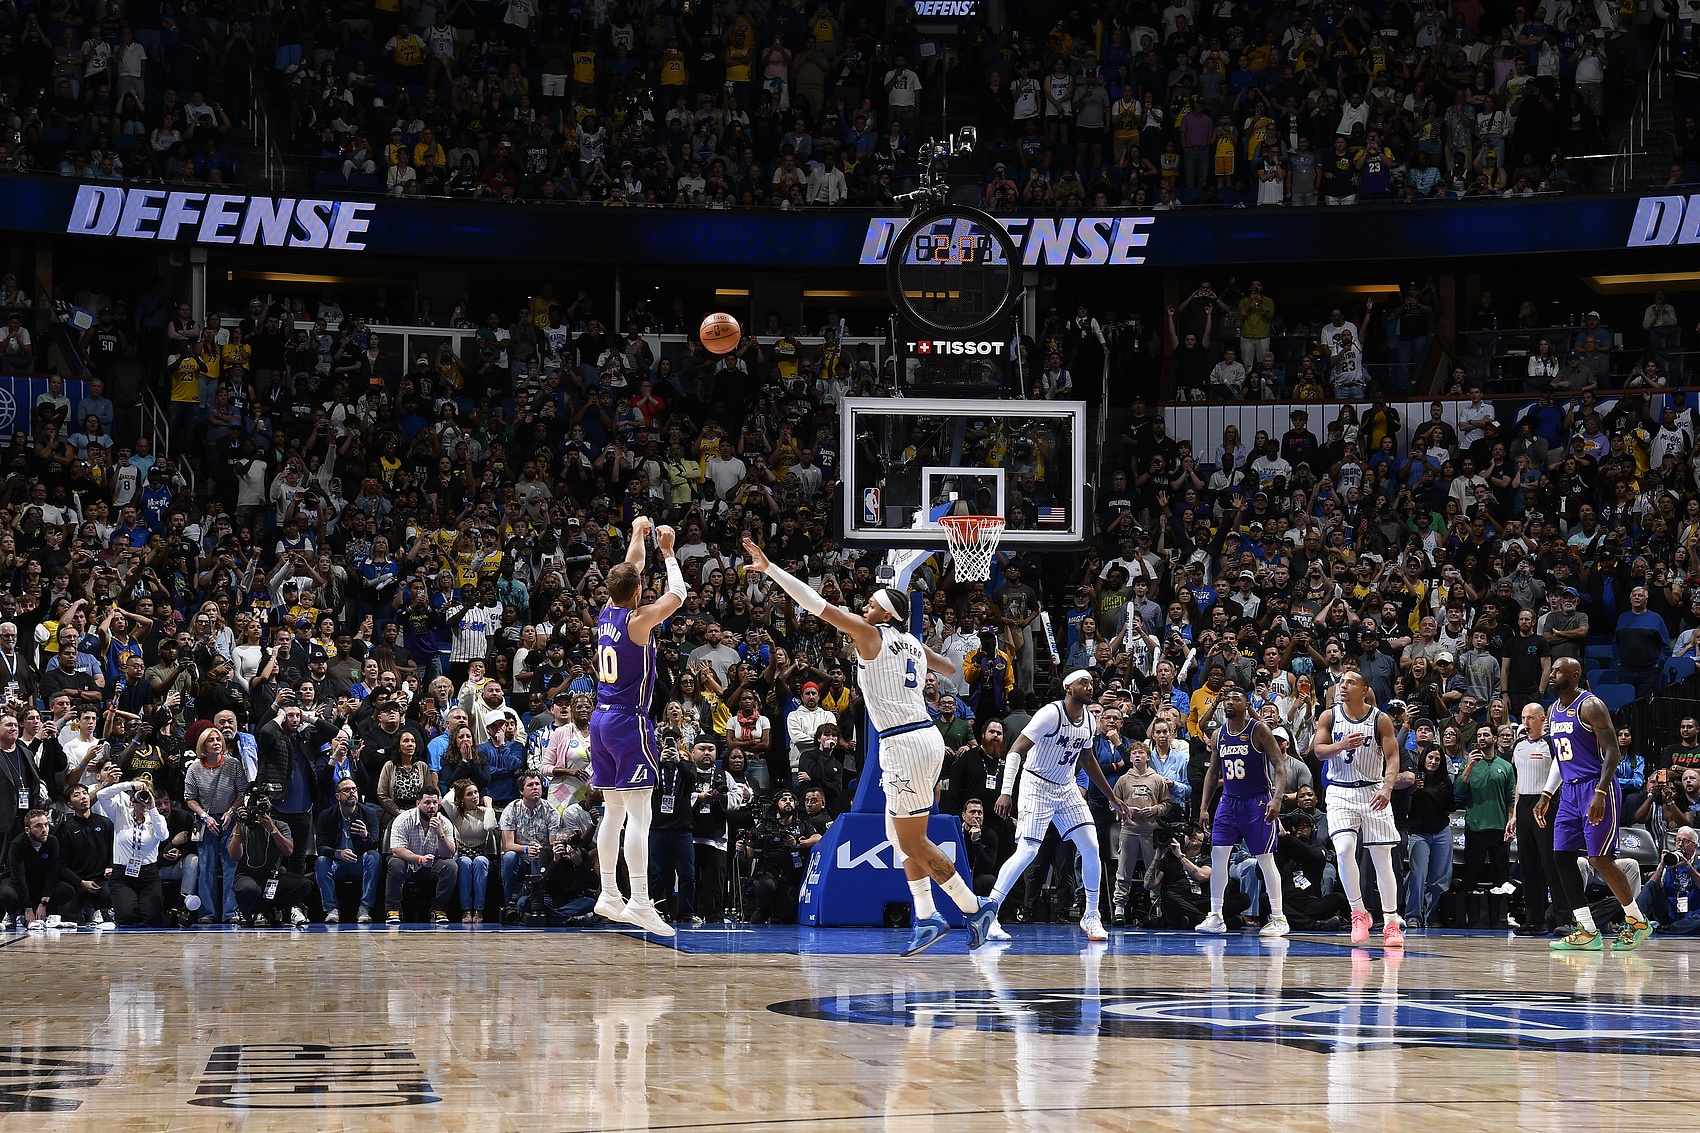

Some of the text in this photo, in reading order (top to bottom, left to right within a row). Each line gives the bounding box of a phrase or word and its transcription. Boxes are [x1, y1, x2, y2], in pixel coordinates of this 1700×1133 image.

[914, 0, 979, 16] DEFENS
[820, 22, 827, 30] 15
[404, 52, 415, 61] 77
[1372, 56, 1384, 64] 23
[669, 63, 680, 71] 23
[1220, 136, 1228, 144] 77
[1369, 162, 1381, 173] 23
[66, 185, 377, 250] DEFENSE
[102, 341, 114, 351] 50
[933, 342, 1004, 355] TISSOT
[1342, 361, 1357, 372] 23
[181, 372, 194, 383] 23
[1627, 445, 1634, 455] 6
[1665, 442, 1676, 451] 15
[990, 451, 997, 461] 6
[781, 457, 794, 467] 23
[123, 481, 131, 491] 8
[1343, 476, 1355, 486] 34
[253, 607, 269, 624] 24
[905, 659, 918, 688] 5
[1219, 744, 1249, 758] LAKERS
[1058, 751, 1077, 767] 34
[1345, 749, 1357, 765] 3
[1224, 758, 1245, 780] 36
[187, 1043, 443, 1109] CENTER
